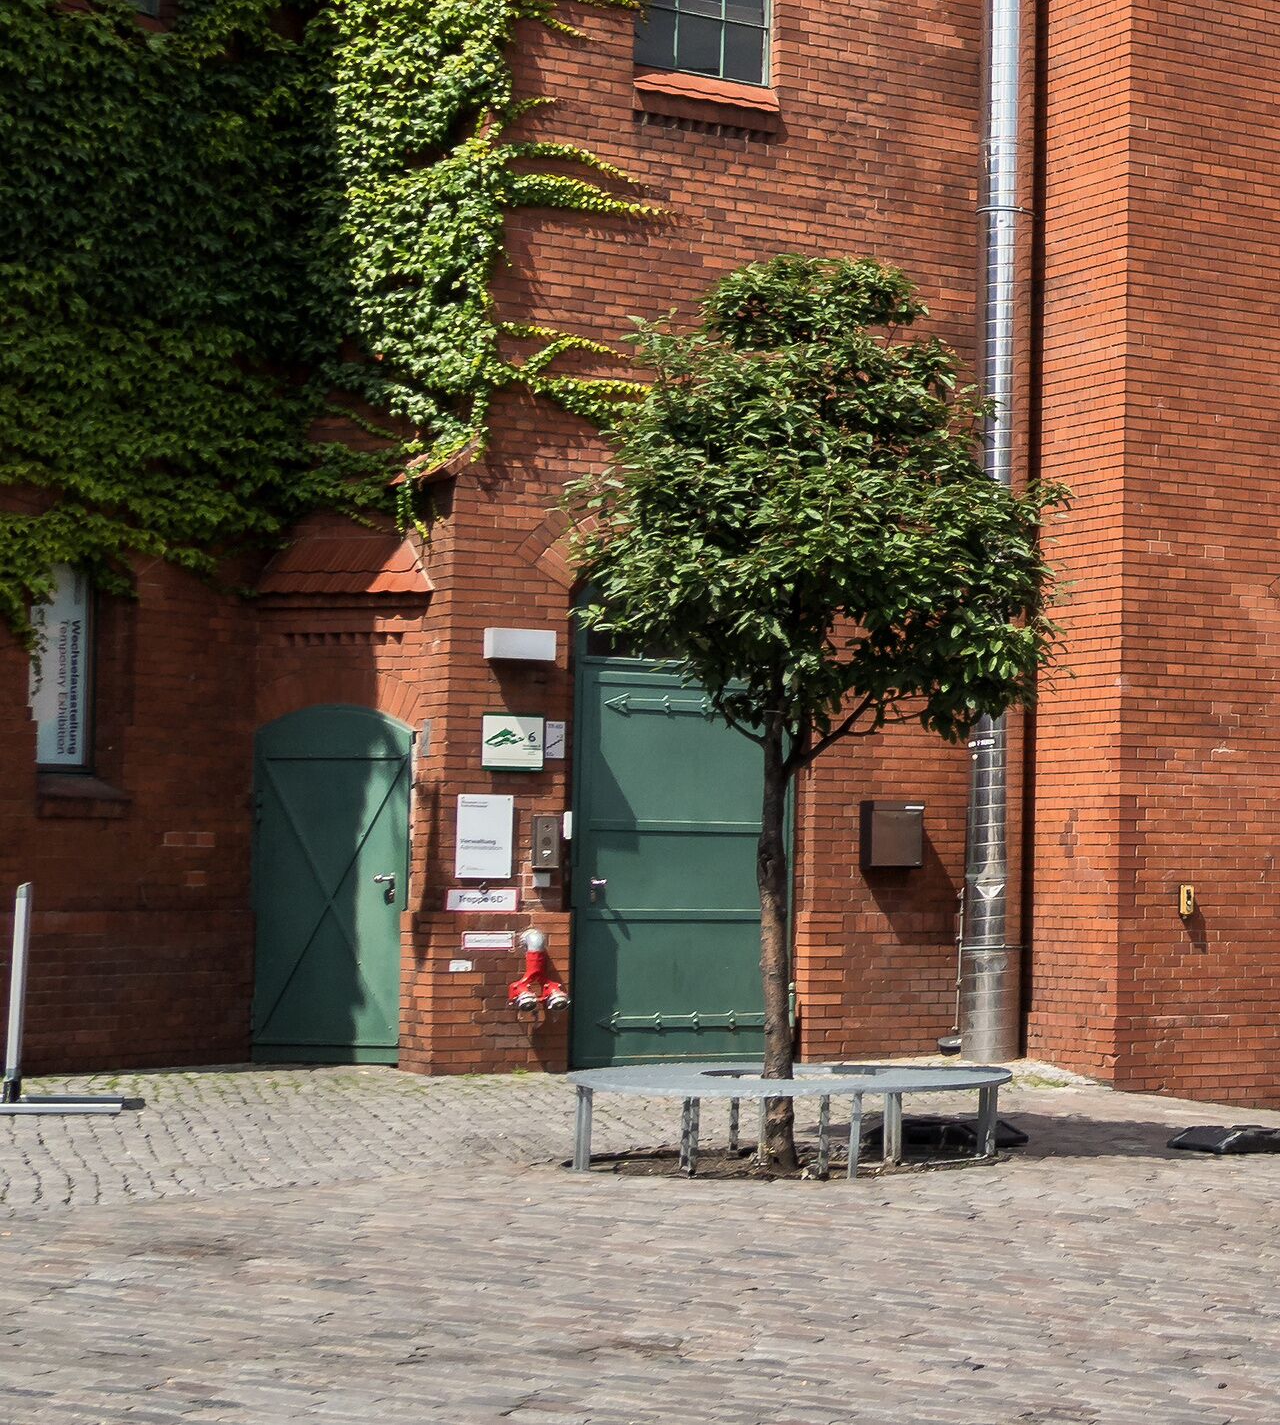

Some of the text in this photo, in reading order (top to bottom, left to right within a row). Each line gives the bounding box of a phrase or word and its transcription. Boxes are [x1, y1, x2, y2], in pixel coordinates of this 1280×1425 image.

[56, 620, 70, 755] Temporary Exhibition
[67, 620, 81, 755] Wechselausstellung
[528, 731, 536, 742] 6
